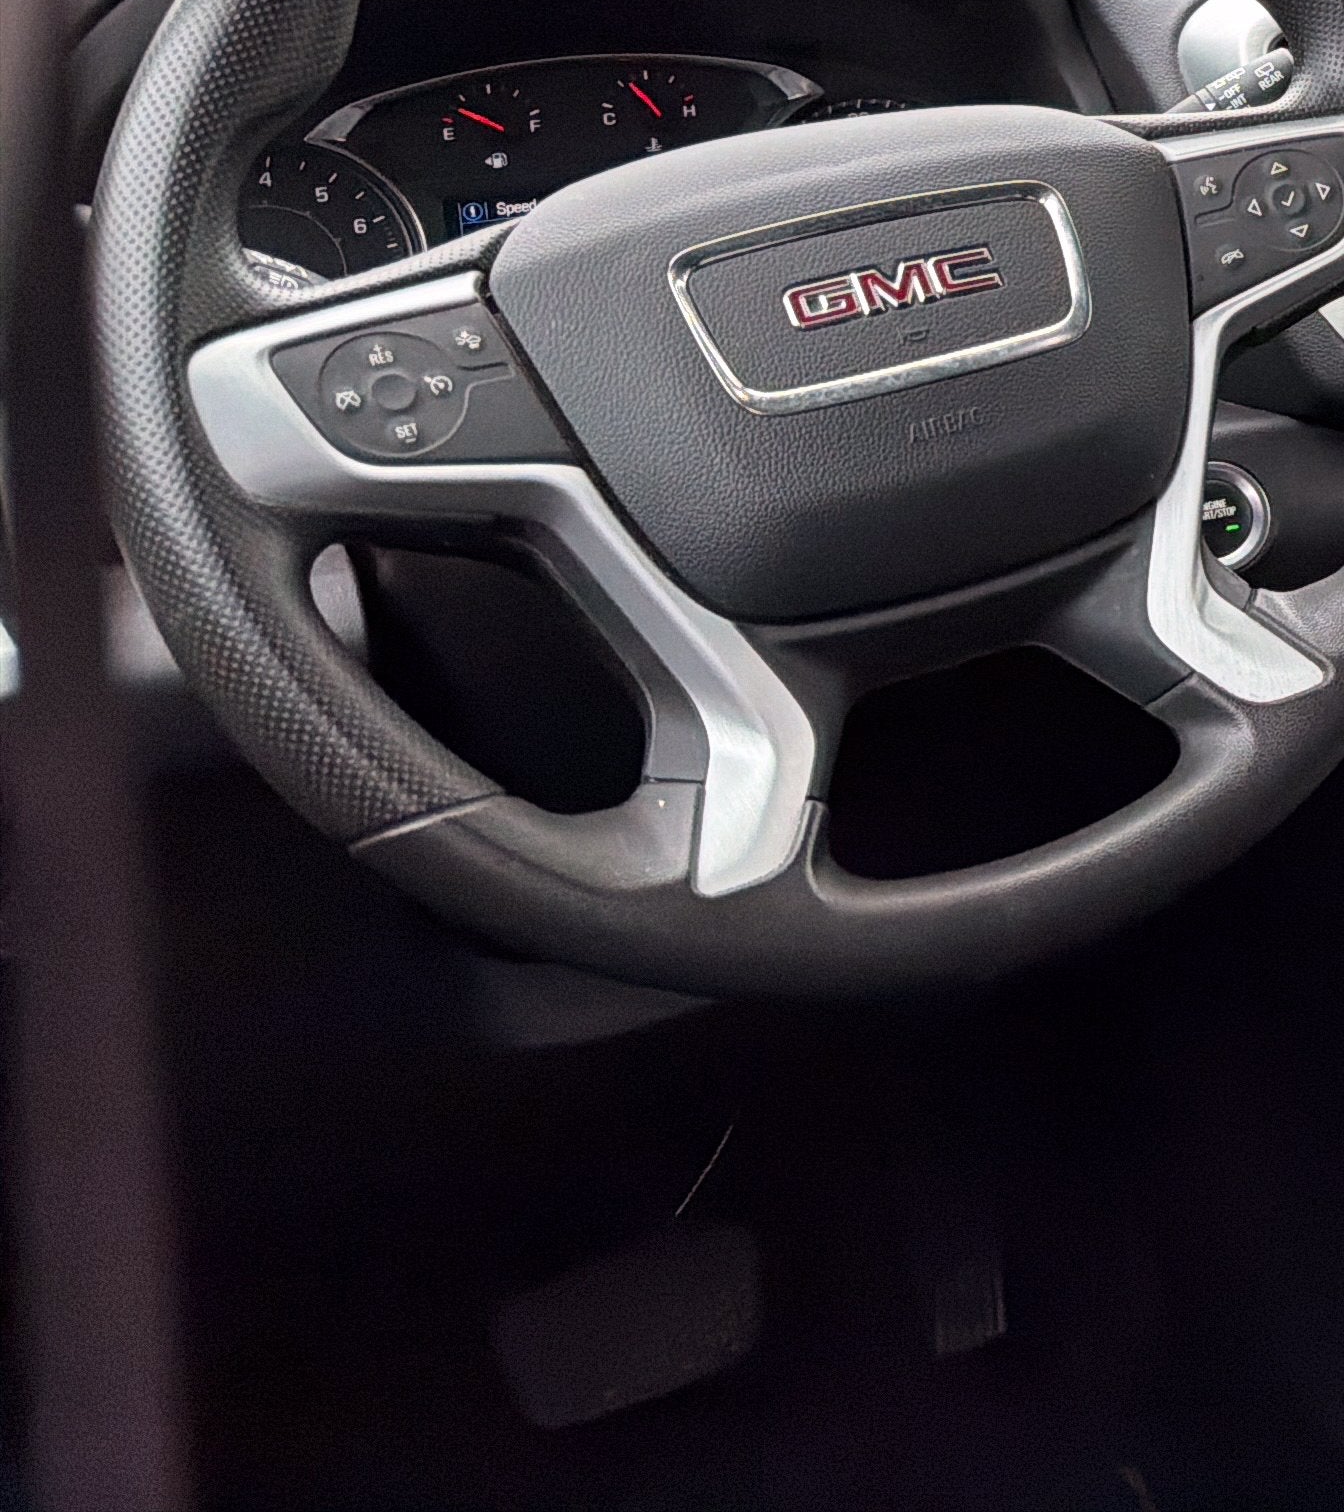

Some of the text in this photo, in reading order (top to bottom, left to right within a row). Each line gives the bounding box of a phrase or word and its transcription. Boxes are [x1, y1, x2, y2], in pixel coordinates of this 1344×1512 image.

[682, 104, 697, 118] H
[530, 120, 541, 133] F
[602, 113, 617, 126] C
[443, 127, 455, 141] E
[259, 172, 272, 188] 4
[315, 187, 329, 202] 5
[496, 199, 538, 216] Speed
[353, 218, 367, 234] 6
[782, 246, 1004, 329] GMC
[368, 350, 394, 367] RES
[395, 423, 418, 439] SET
